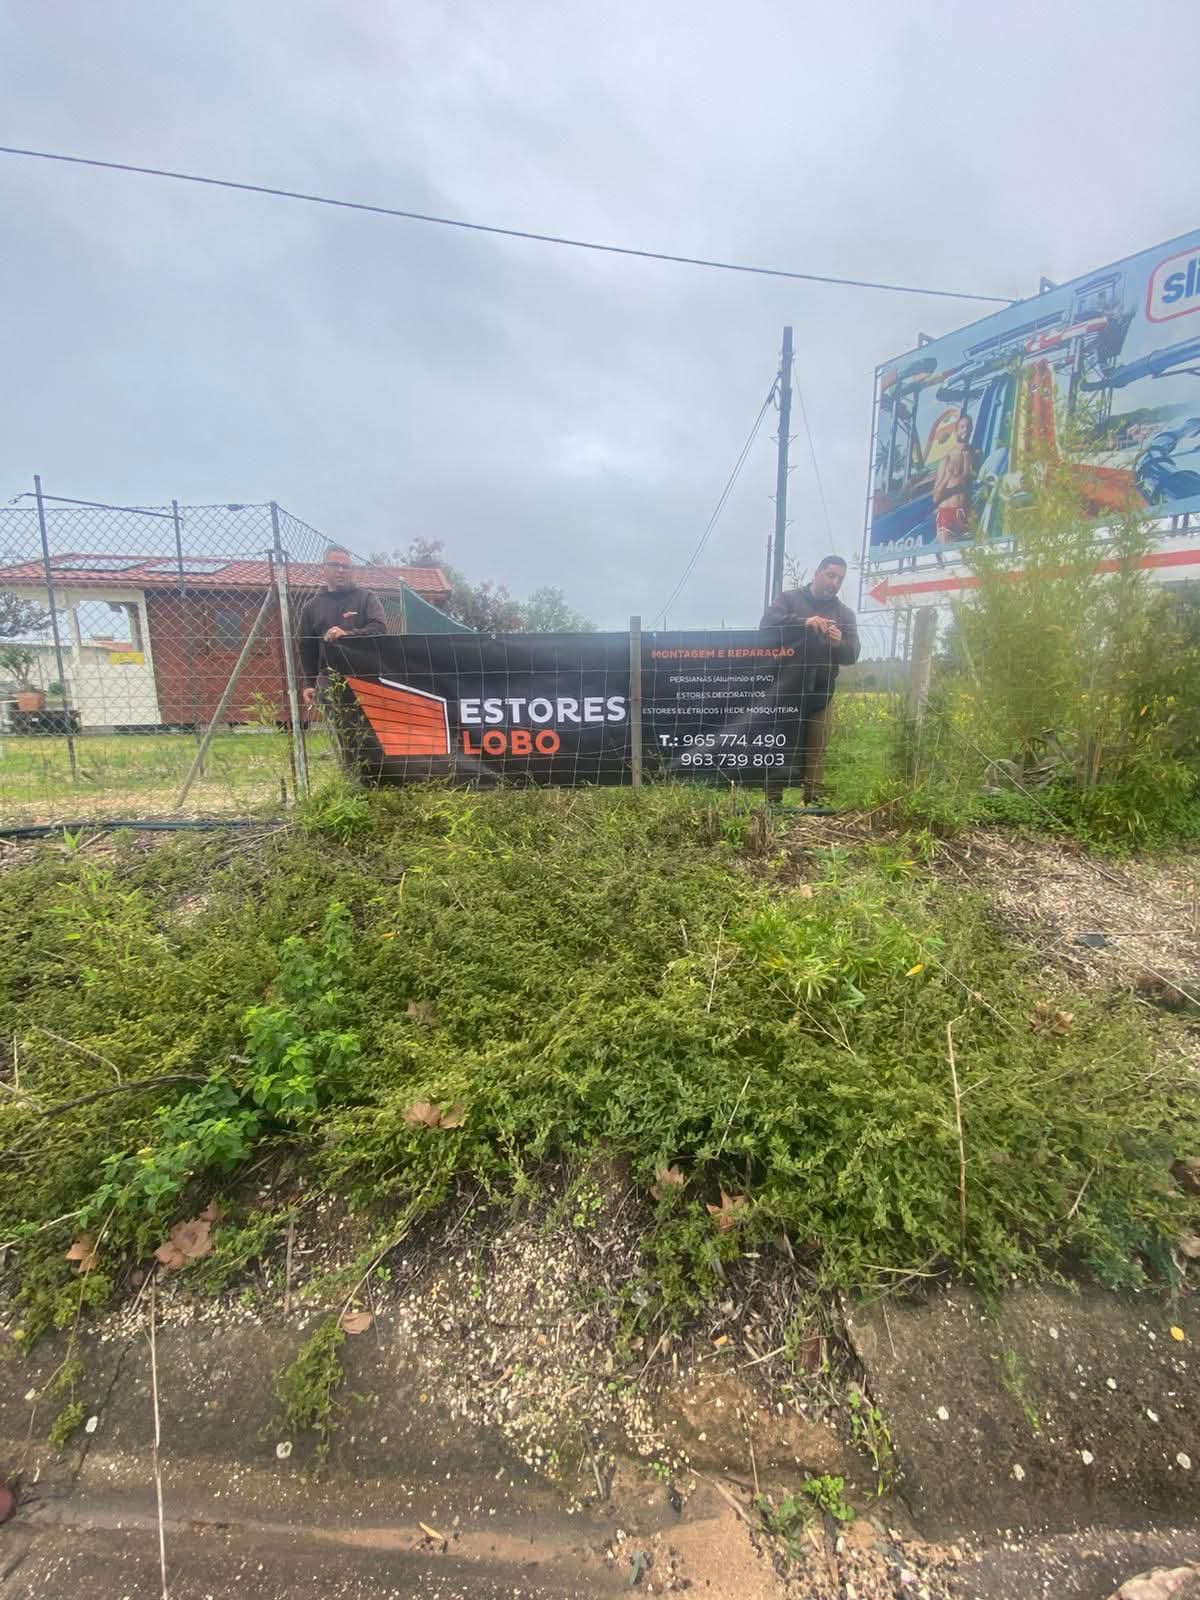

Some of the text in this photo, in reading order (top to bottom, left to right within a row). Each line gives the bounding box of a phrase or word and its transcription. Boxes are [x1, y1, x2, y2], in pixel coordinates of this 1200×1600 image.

[652, 646, 796, 659] MONTAGEM E REPARAÇÃO
[669, 675, 713, 683] PERSIANAS
[676, 690, 767, 699] ESTORES DECORATIVOS
[459, 695, 627, 725] ESTORES
[642, 707, 677, 715] ESTORES
[724, 706, 745, 714] REDE
[746, 706, 800, 715] MOSQUITEIRA
[463, 729, 561, 756] LOBO
[683, 734, 716, 747] 965
[720, 734, 748, 747] 774
[752, 734, 787, 747] 490
[681, 753, 786, 766] 963 739 803
